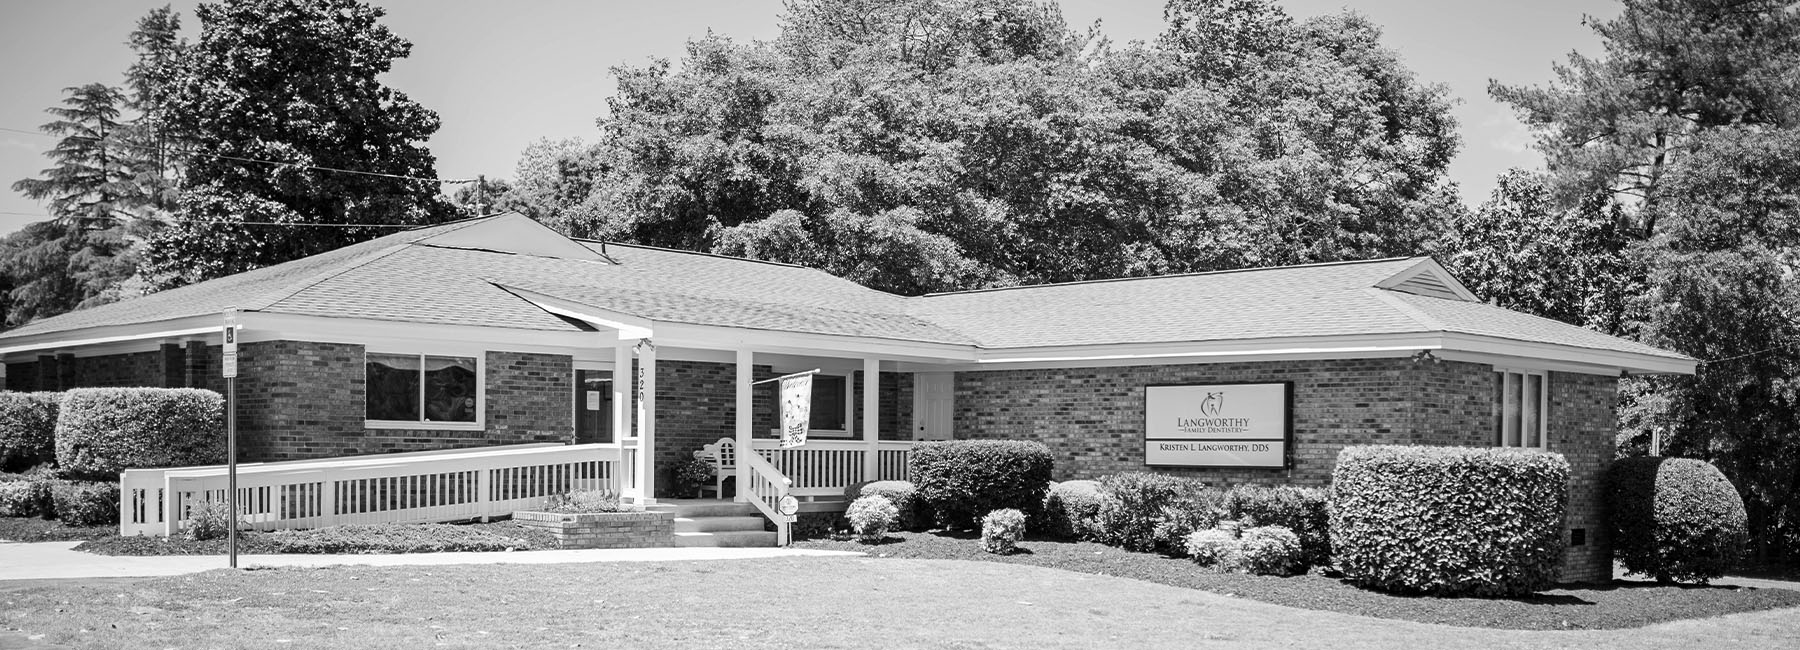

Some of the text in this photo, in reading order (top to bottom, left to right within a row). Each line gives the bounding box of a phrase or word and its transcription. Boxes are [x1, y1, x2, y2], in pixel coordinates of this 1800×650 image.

[1177, 417, 1250, 428] LANGWORTHY
[1159, 443, 1189, 451] KRISTEN
[1198, 443, 1250, 452] LANGWORTHY,
[1252, 444, 1270, 452] DDS
